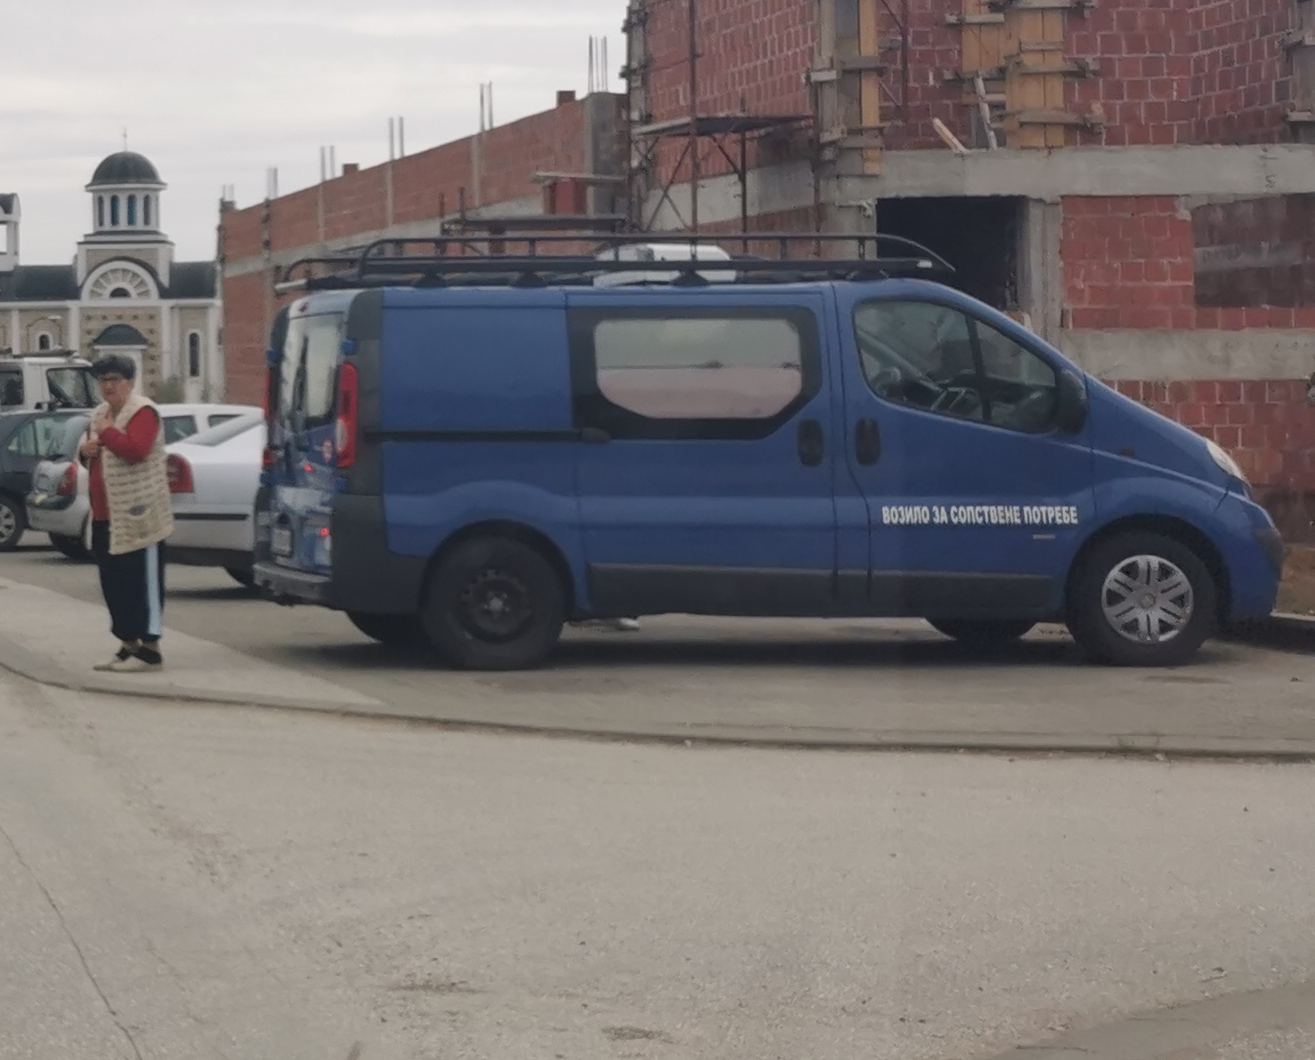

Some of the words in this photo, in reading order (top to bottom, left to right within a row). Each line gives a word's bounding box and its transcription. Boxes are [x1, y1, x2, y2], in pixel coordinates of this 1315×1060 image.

[881, 505, 930, 525] ВОЗИЛО
[932, 505, 949, 524] ЗА
[950, 505, 1021, 524] СОПСТВЕНЕ
[1023, 505, 1079, 525] ПОТРЕБЕ
